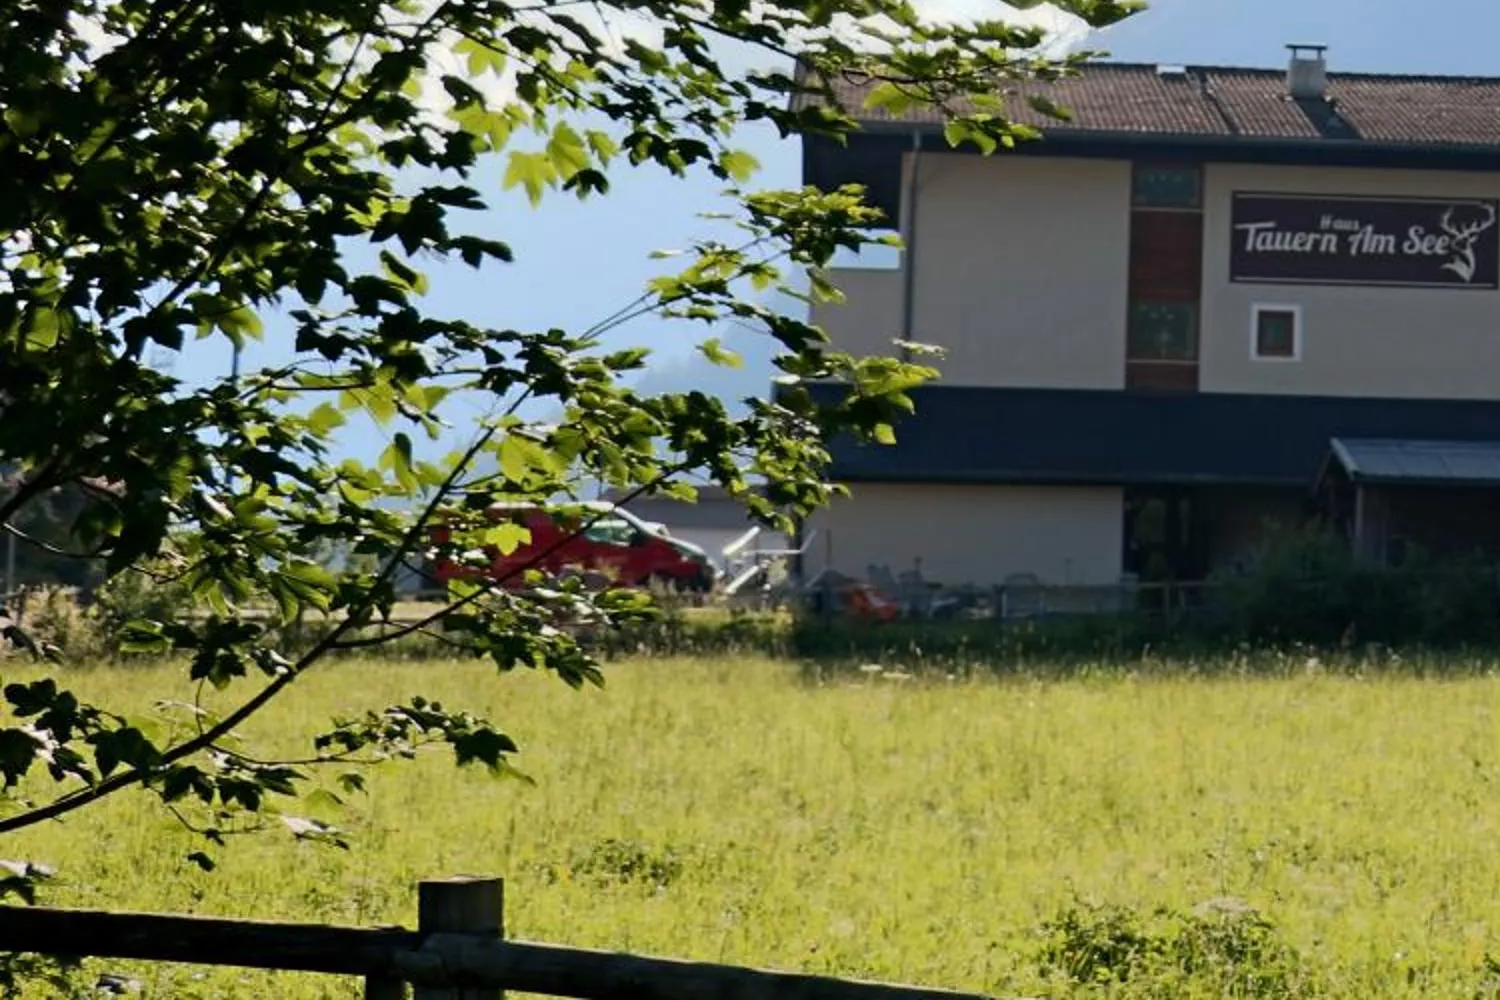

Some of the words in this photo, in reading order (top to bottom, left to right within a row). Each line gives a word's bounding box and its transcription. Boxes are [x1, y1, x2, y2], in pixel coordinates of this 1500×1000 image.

[1320, 214, 1360, 231] Haus
[1234, 221, 1337, 252] Tauern
[1347, 223, 1395, 256] Am
[1402, 225, 1449, 255] See
